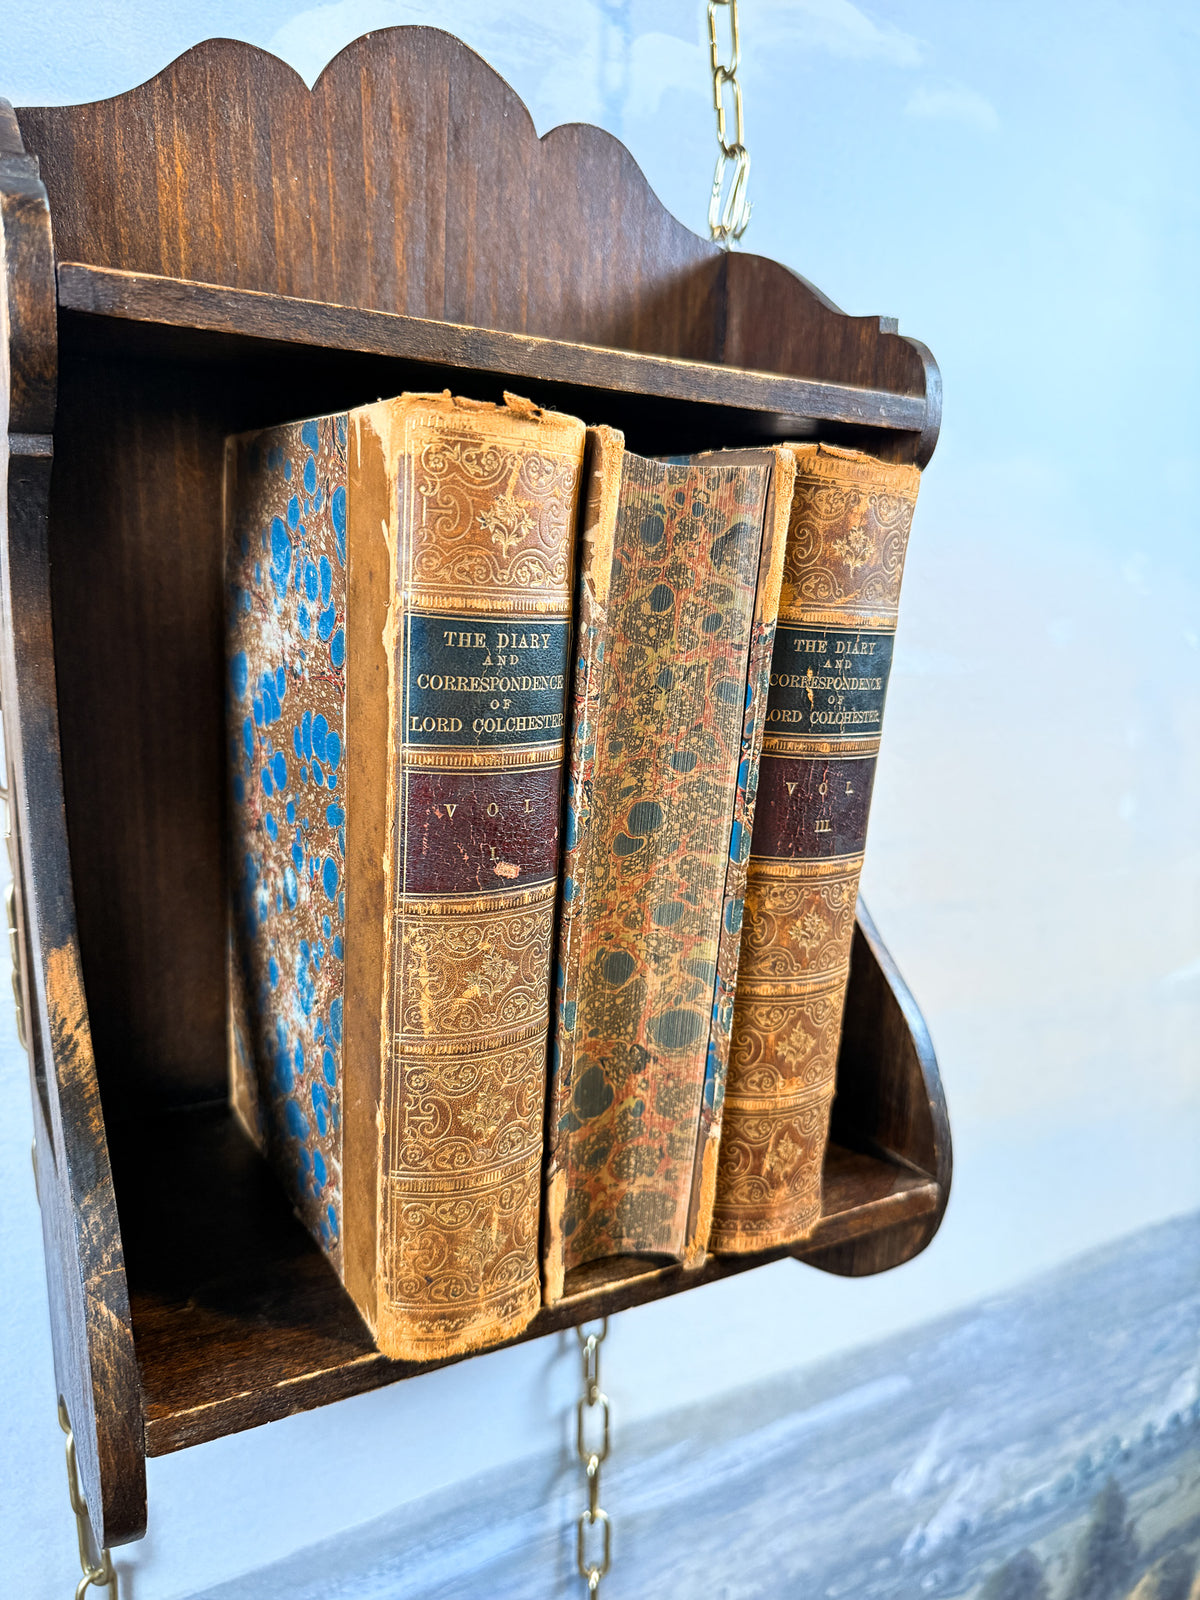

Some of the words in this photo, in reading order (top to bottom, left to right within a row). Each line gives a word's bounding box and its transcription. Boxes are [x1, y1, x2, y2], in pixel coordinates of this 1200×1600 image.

[443, 631, 486, 648] THE
[497, 633, 551, 649] DIARY
[793, 639, 828, 653] THE
[835, 641, 876, 655] DIARY
[482, 654, 519, 665] AND
[823, 659, 852, 669] AND
[417, 673, 564, 692] CORRESPONDENCE
[769, 673, 881, 691] CORRESPONDENCE
[490, 698, 512, 710] OF
[828, 695, 844, 705] OF
[410, 716, 462, 732] LORD
[472, 713, 564, 732] COLCHESTER
